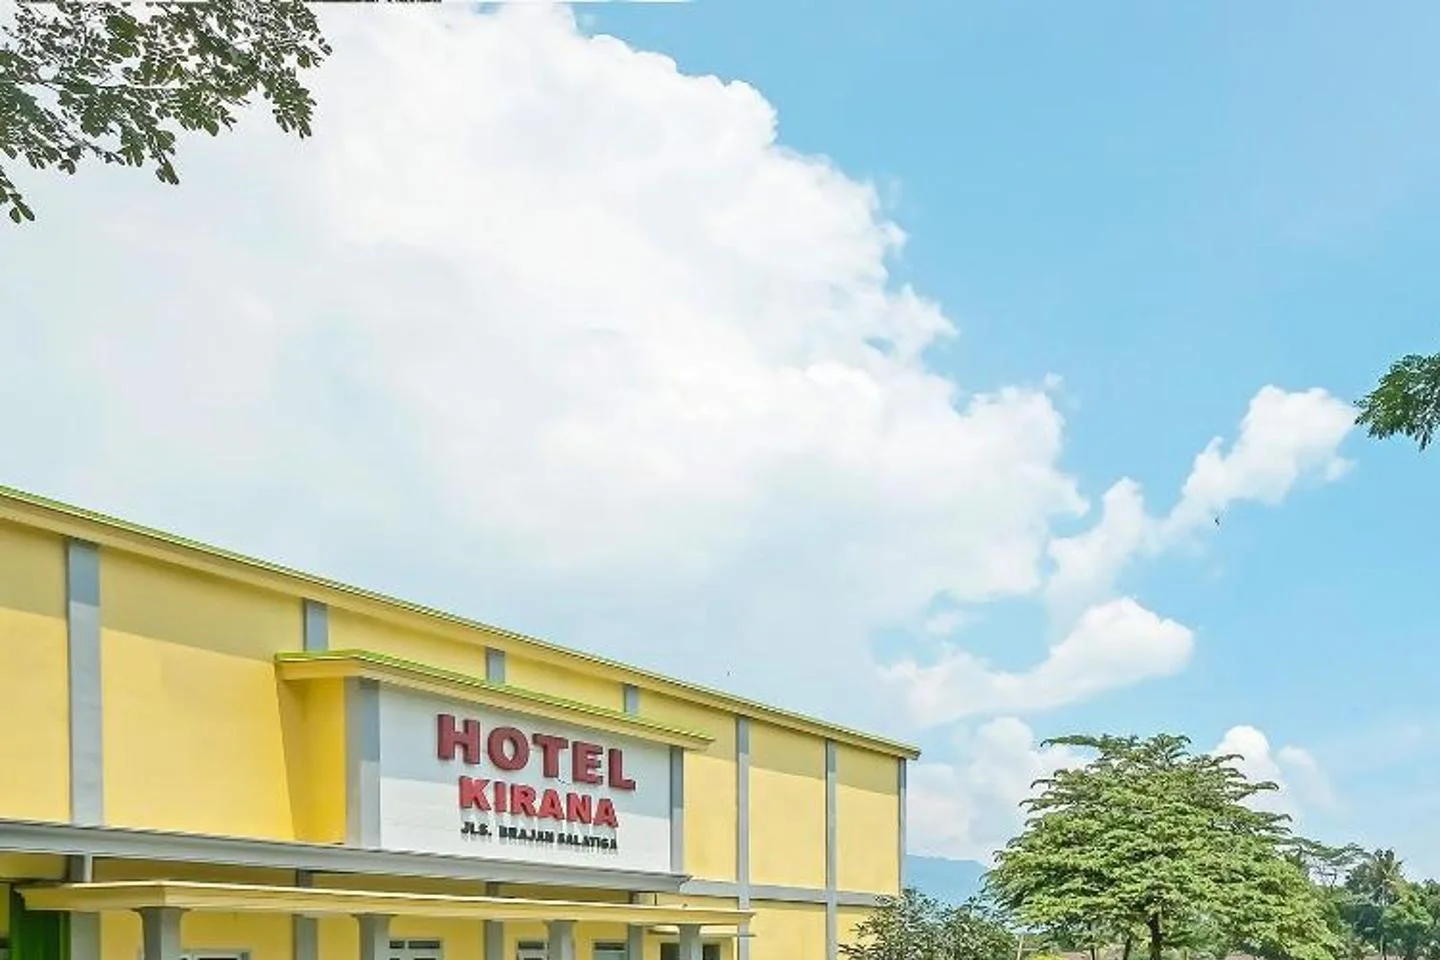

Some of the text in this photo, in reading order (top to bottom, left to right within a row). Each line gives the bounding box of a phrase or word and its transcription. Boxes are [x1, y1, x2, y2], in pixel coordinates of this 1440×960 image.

[437, 714, 636, 791] HOTEL
[458, 776, 619, 828] KIRANA
[498, 825, 555, 843] BRAJAN
[557, 832, 617, 849] SALATIGA
